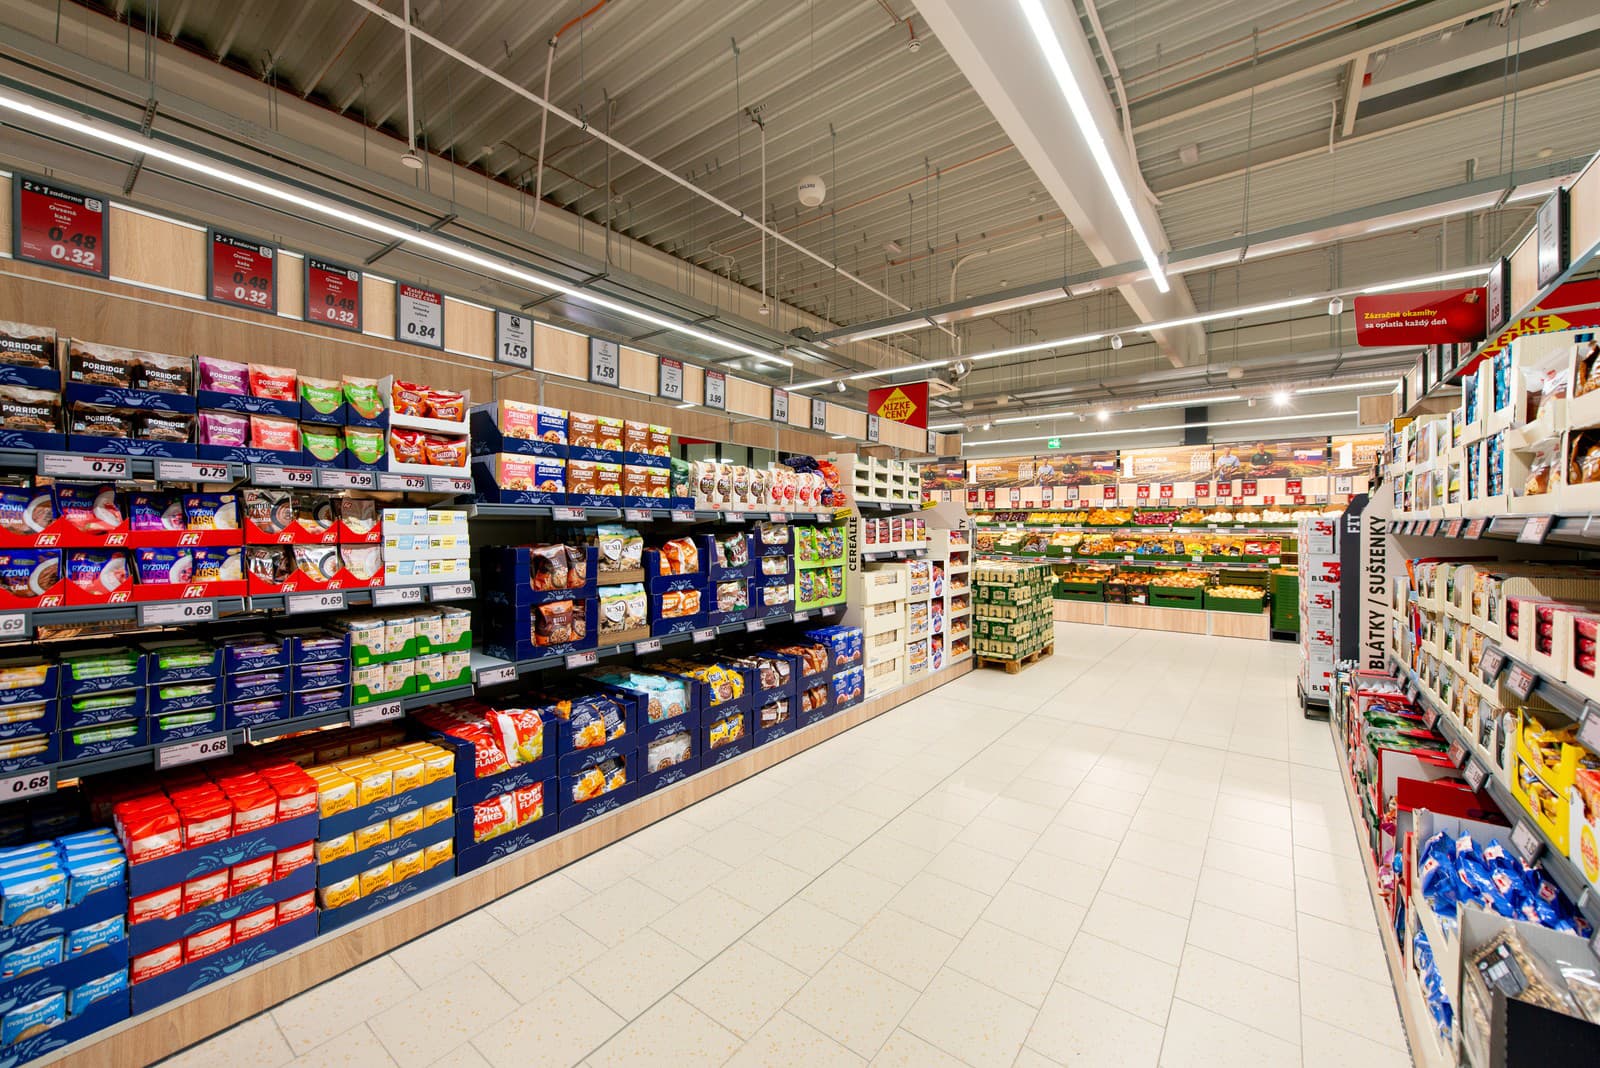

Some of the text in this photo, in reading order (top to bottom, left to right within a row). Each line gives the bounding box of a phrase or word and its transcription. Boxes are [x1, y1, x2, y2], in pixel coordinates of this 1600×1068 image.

[49, 190, 83, 203] zadarmo
[48, 226, 96, 249] 0.48
[234, 241, 258, 251] zadarmo
[51, 244, 95, 266] 0.32
[232, 271, 268, 290] 0.48
[234, 286, 268, 304] 0.32
[324, 294, 354, 311] 0.48
[326, 308, 354, 324] 0.32
[1364, 310, 1400, 320] Zázračné
[1376, 320, 1404, 329] oplatia
[1404, 319, 1430, 328] každý
[1431, 318, 1447, 326] deň
[407, 322, 435, 338] 0.84
[504, 342, 528, 359] 1.58
[82, 361, 125, 374] PORRIDGE
[596, 364, 615, 379] 1.58
[145, 370, 182, 380] PORRIDGE
[209, 372, 242, 382] PORRIDGE
[258, 379, 289, 388] PORRIDGE
[664, 383, 678, 394] 2.57
[708, 394, 722, 404] 3.99
[2, 404, 50, 416] PORRIDGE
[508, 410, 534, 420] CRUNCHY
[885, 409, 909, 420] CENY
[148, 418, 185, 428] PORRIDGE
[540, 416, 564, 426] CRUNCHY
[209, 425, 242, 434] PORRIDGE
[261, 429, 291, 438] PORRIDGE
[1334, 442, 1358, 470] 1
[92, 460, 125, 474] 0.79
[199, 467, 227, 478] 0.79
[506, 464, 532, 472] CRUNCHY
[538, 466, 562, 474] CRUNCHY
[288, 472, 312, 482] 0.99
[350, 476, 372, 485] 0.99
[406, 478, 425, 488] 0.79
[454, 481, 472, 490] 0.49
[1346, 513, 1360, 534] FIT
[38, 534, 56, 546] Fit
[107, 534, 125, 545] Fit
[180, 533, 200, 545] Fit
[278, 533, 294, 542] Fit
[323, 533, 337, 542] Fit
[366, 532, 380, 541] Fit
[848, 516, 858, 572] CEREÁLIE
[1366, 516, 1386, 595] SUŠIENKY
[281, 583, 296, 592] Fit
[328, 580, 342, 590] Fit
[370, 578, 384, 586] Fit
[184, 585, 204, 598] Fit
[401, 590, 420, 599] 0.99
[456, 586, 472, 594] 0.99
[41, 596, 60, 608] Fit
[110, 592, 128, 603] Fit
[320, 596, 342, 606] 0.69
[184, 606, 212, 616] 0.69
[500, 668, 514, 678] 1.44
[382, 704, 400, 716] 0.68
[200, 742, 226, 754] 0.68
[12, 776, 49, 792] 0.68
